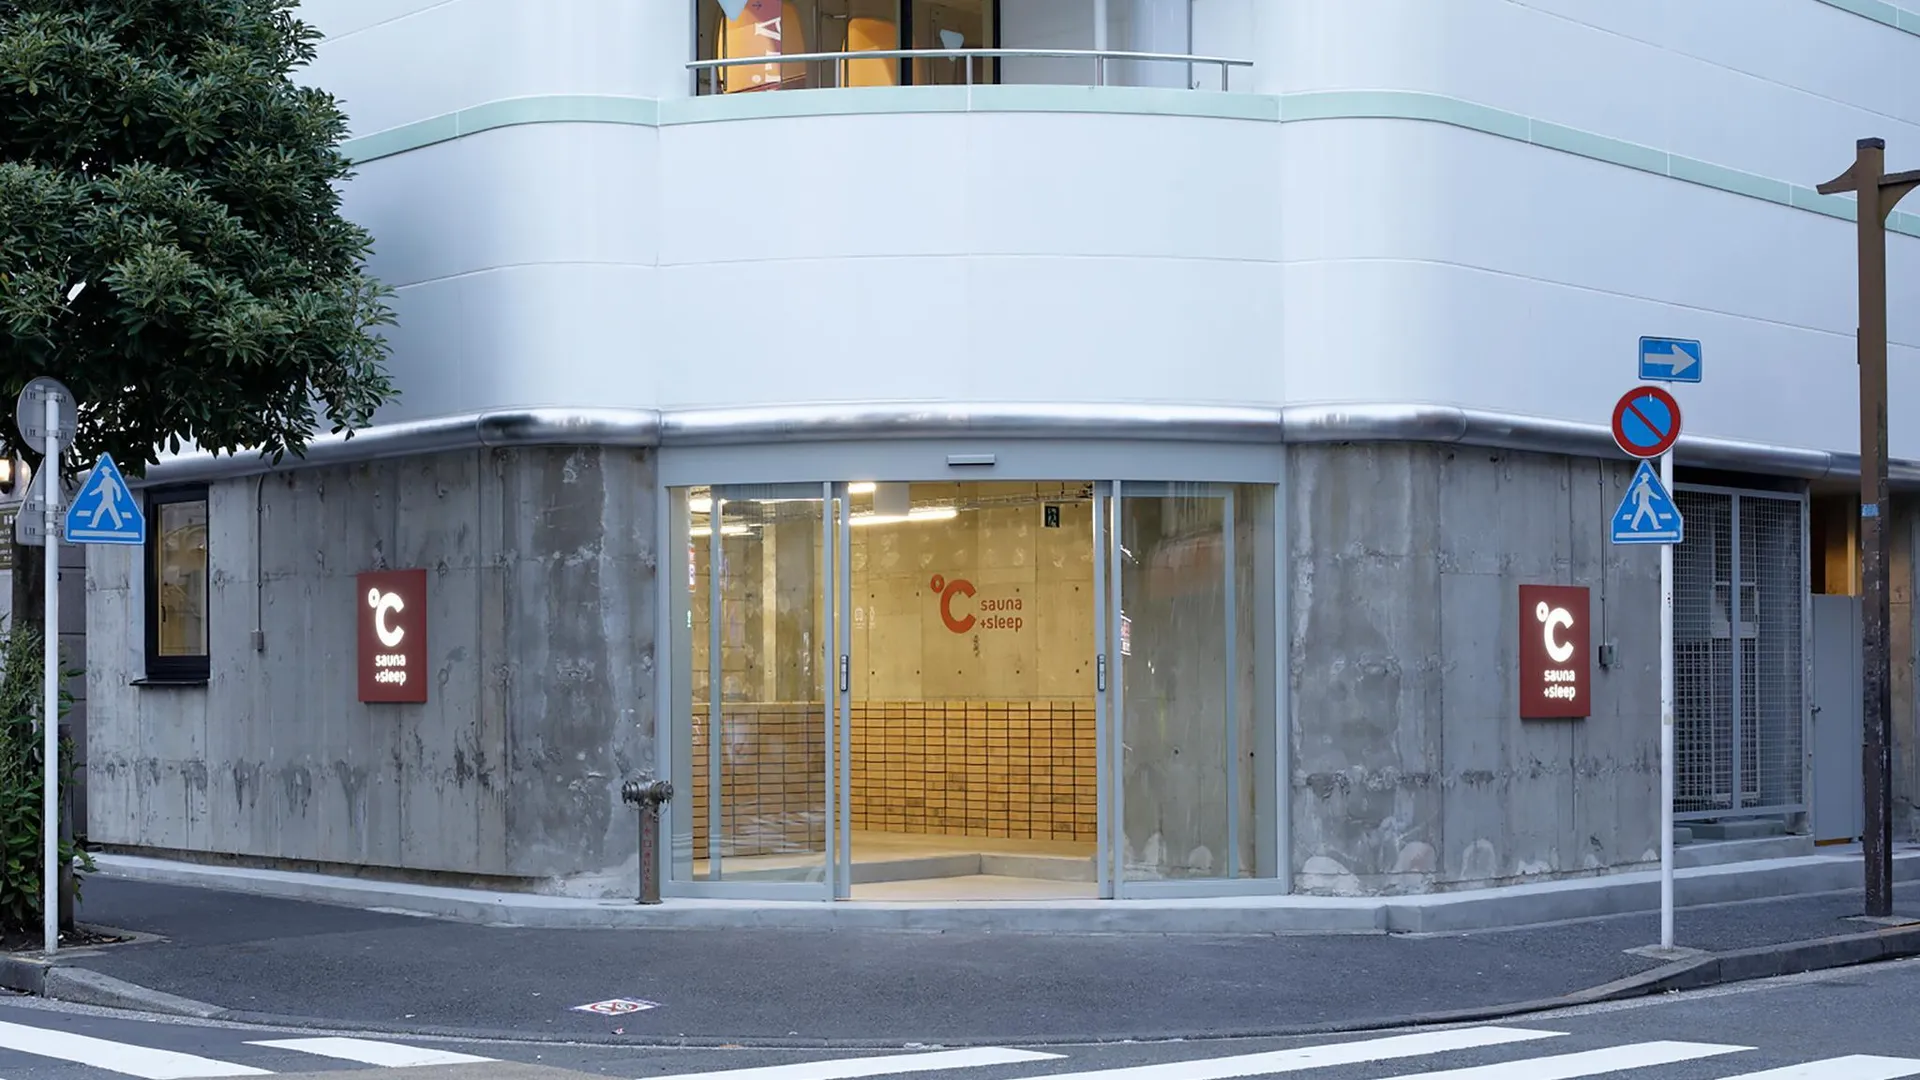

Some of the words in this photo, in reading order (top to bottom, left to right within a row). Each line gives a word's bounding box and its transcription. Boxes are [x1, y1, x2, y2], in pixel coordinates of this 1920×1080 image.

[980, 599, 1022, 611] sauna
[980, 615, 1023, 632] +sleep
[375, 654, 406, 667] sauna
[375, 669, 407, 686] +sleep
[1544, 670, 1575, 682] sauna
[1544, 684, 1576, 701] +sleep
